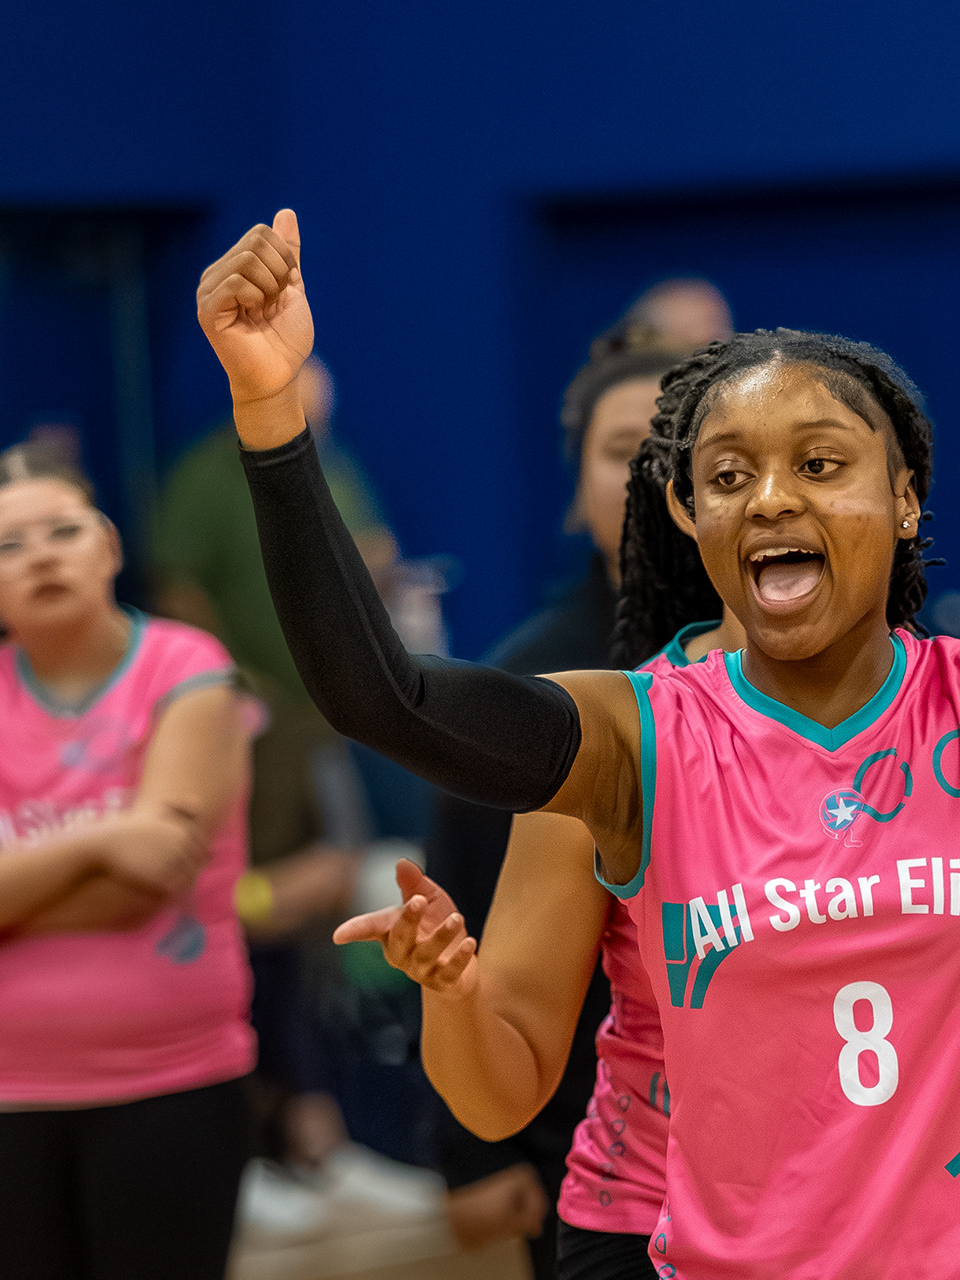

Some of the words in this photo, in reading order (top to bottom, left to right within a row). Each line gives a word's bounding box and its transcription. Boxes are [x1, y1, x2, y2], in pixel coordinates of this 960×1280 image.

[689, 882, 755, 961] All
[764, 873, 880, 932] Star
[832, 980, 900, 1107] 8
